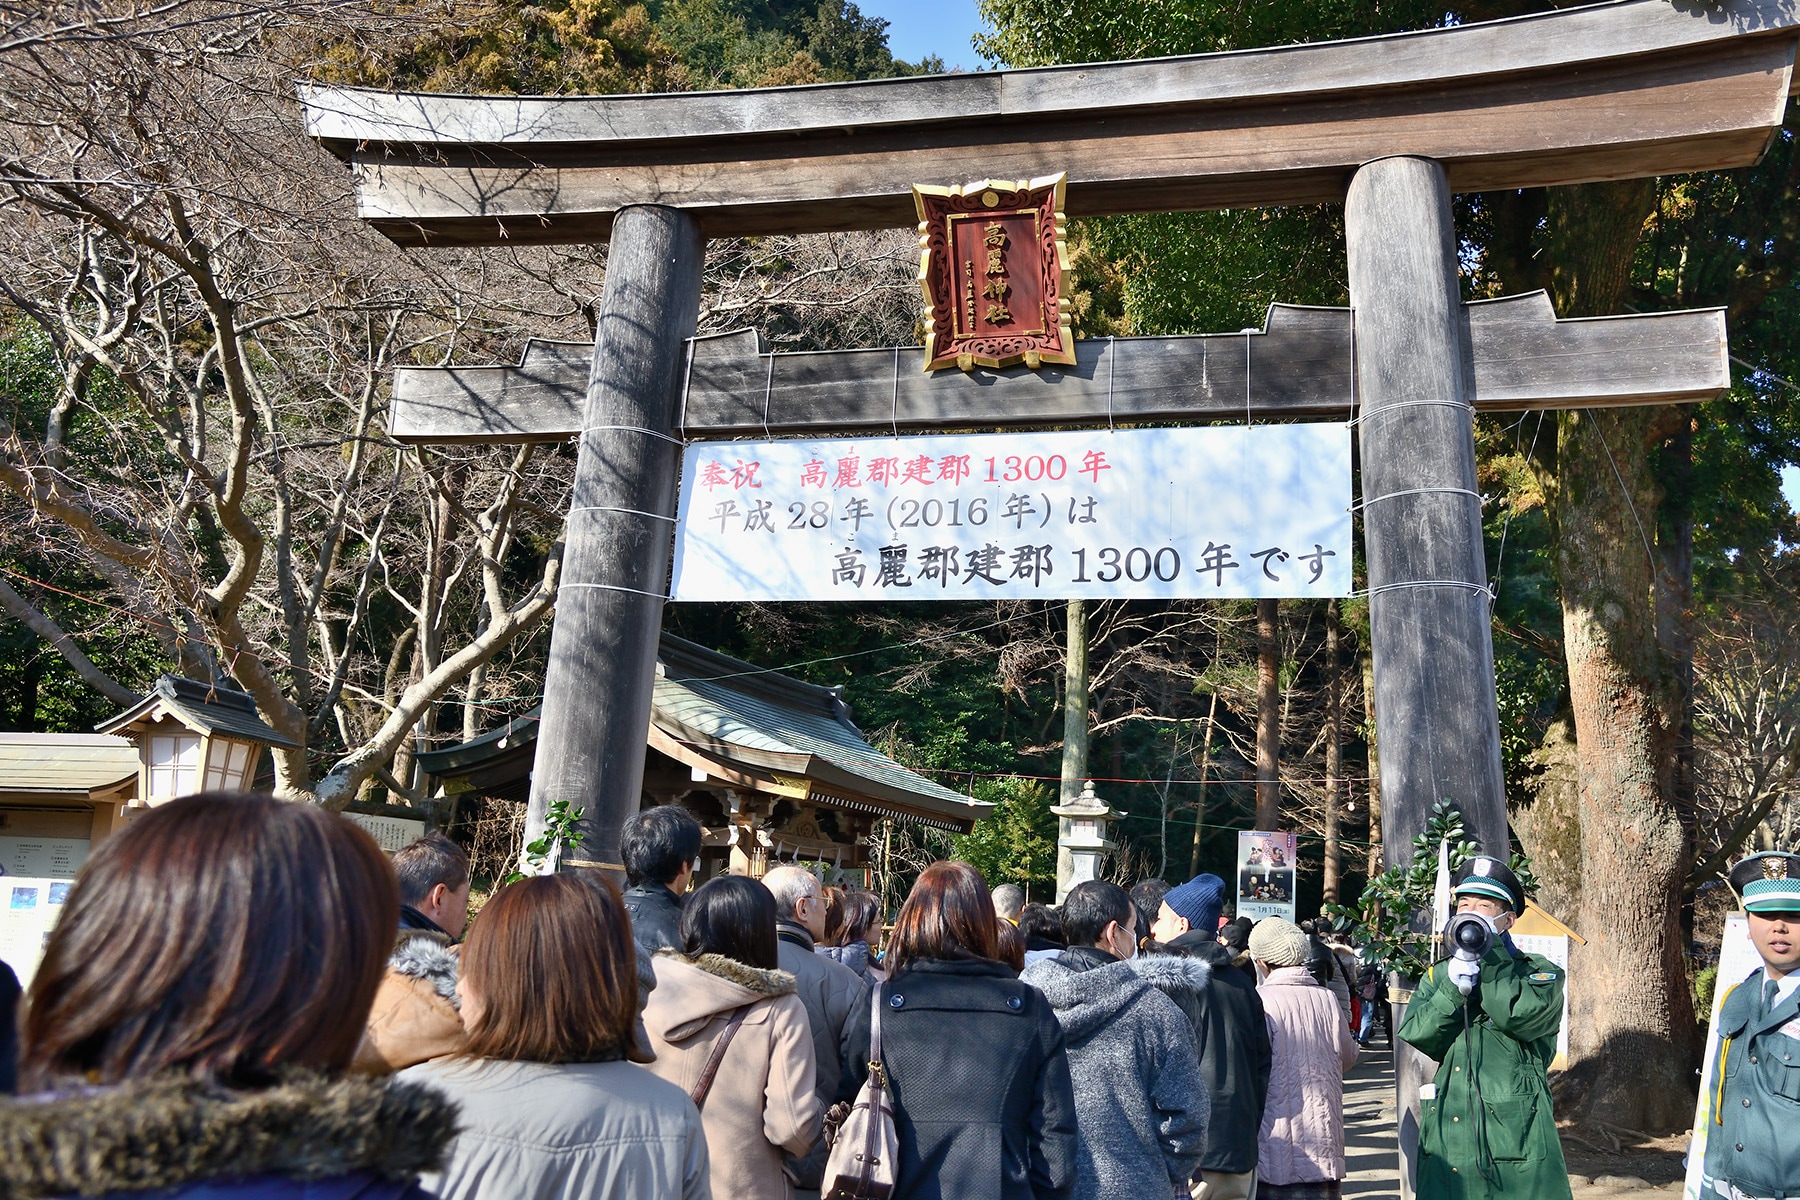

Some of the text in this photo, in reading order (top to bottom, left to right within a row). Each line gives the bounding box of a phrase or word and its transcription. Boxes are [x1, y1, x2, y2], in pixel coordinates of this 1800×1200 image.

[982, 221, 1010, 324] 高麗神社
[700, 458, 763, 492] 奉祝
